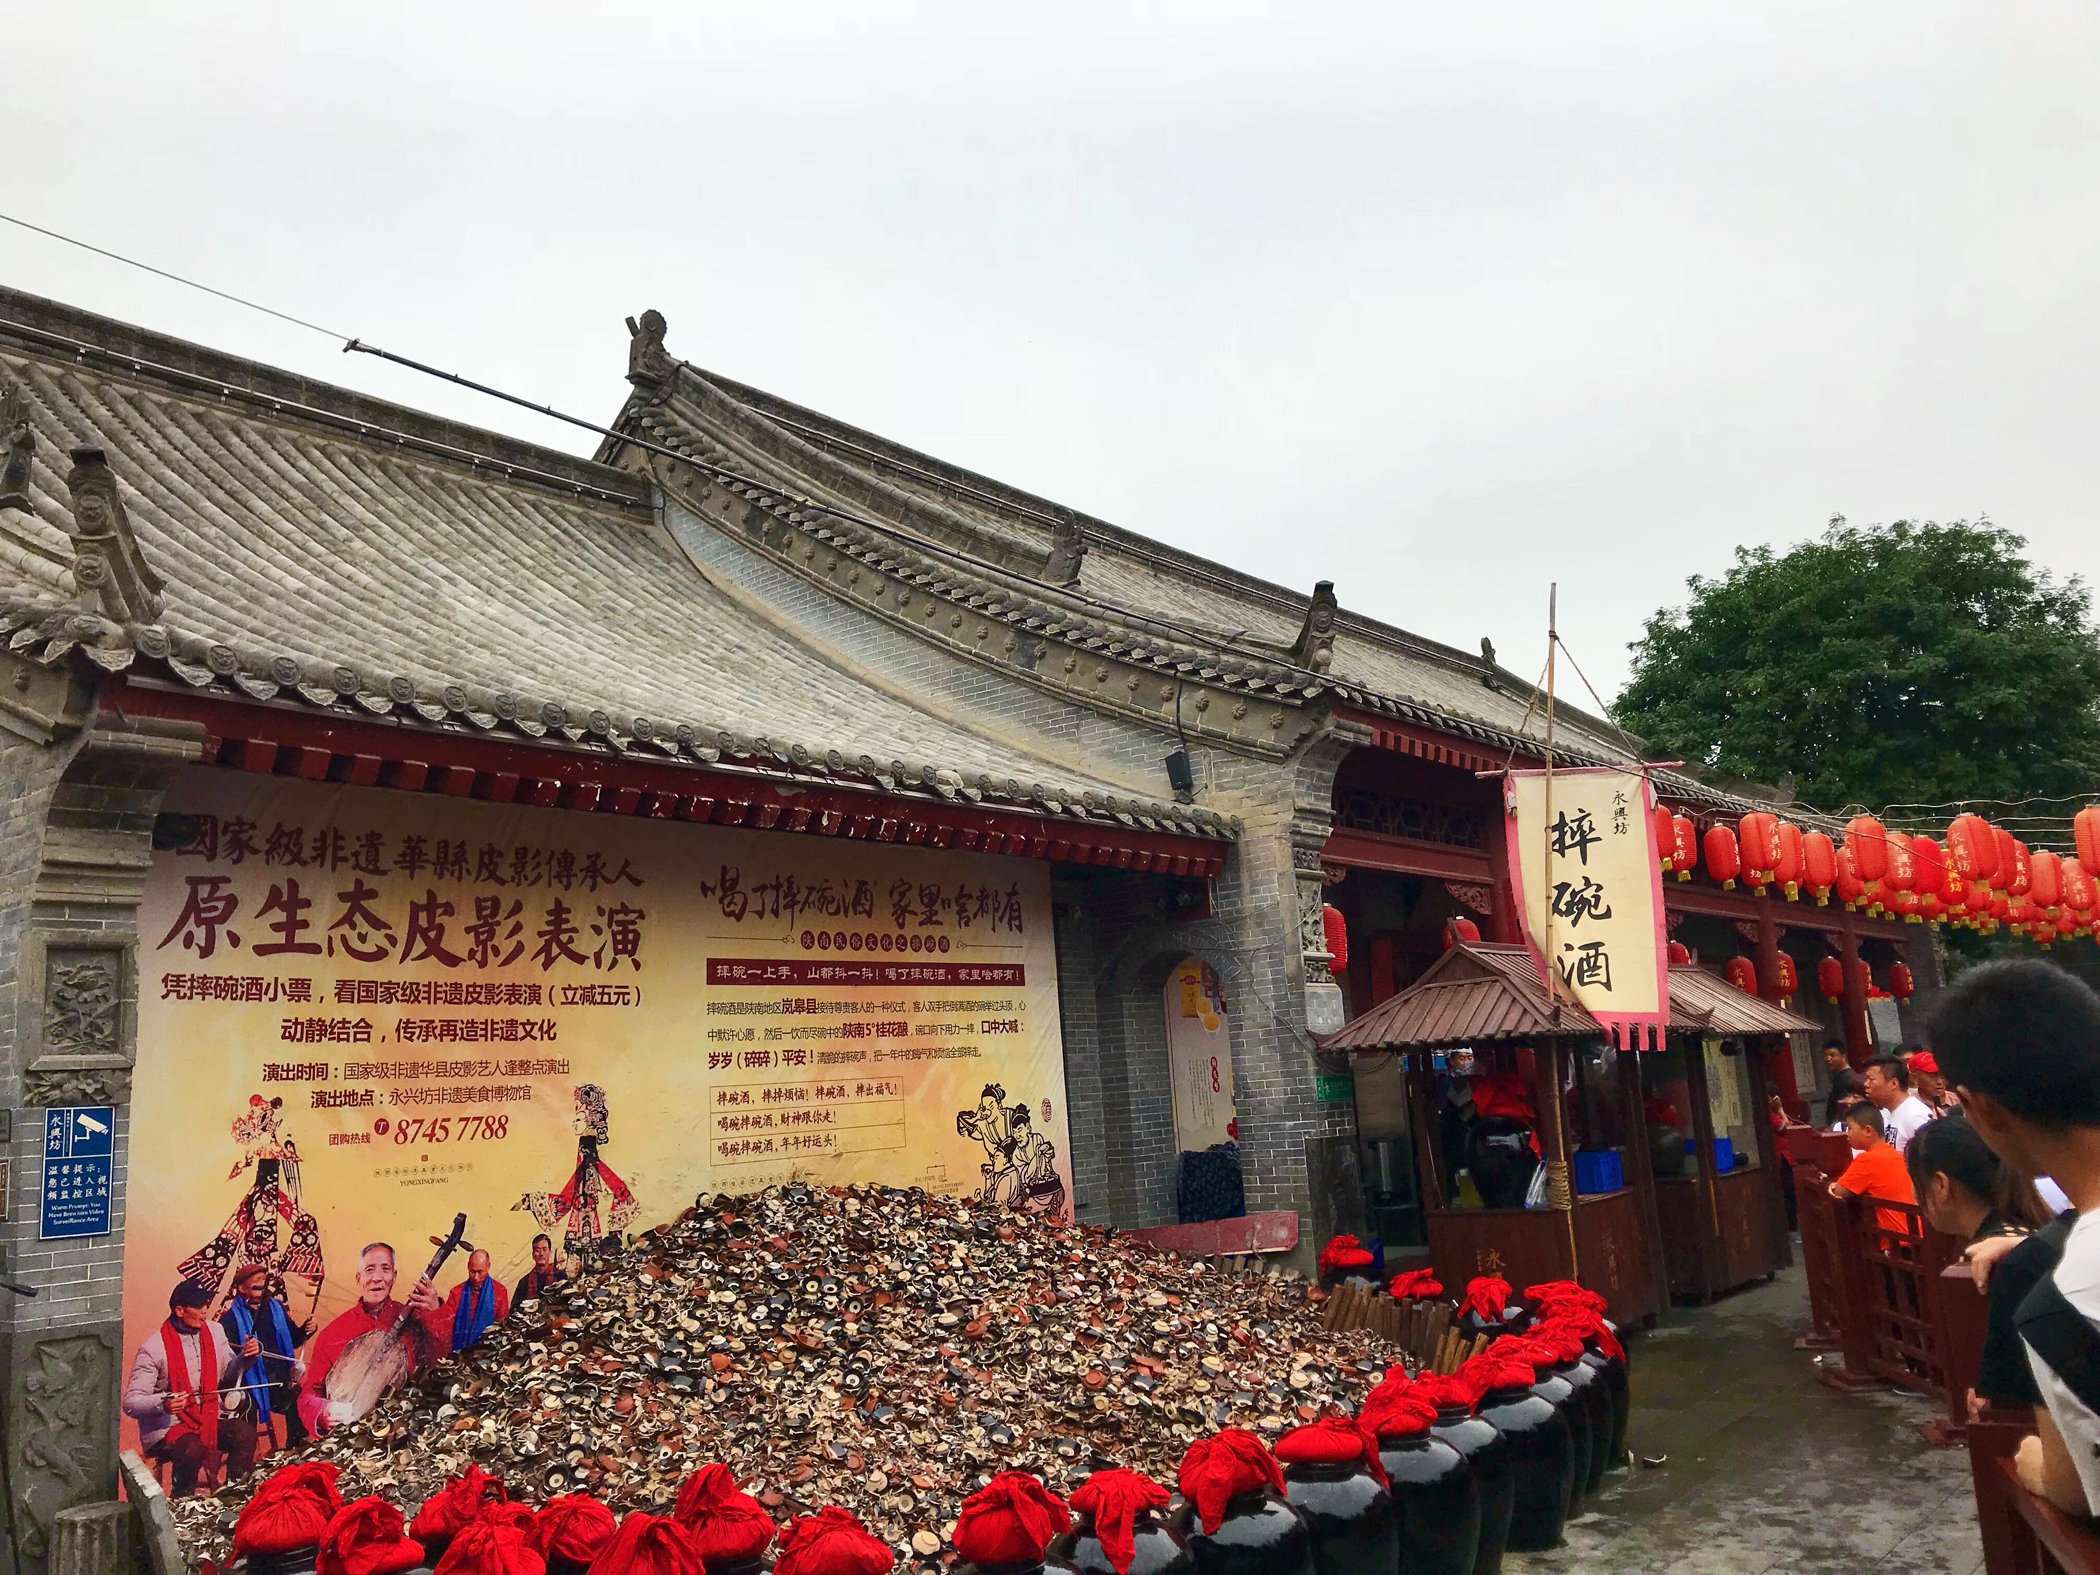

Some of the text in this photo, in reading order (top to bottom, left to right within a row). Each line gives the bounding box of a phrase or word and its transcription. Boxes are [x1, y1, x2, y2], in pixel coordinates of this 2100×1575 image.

[1611, 790, 1630, 836] 永興坊
[1551, 807, 1613, 992] 摔碗酒
[156, 875, 646, 972] 原生态皮影表演
[280, 1016, 557, 1043] 动静结合，传承再造非遗文化
[328, 1132, 371, 1146] 团购热线
[393, 1117, 451, 1146] 8745
[457, 1114, 509, 1141] 7788
